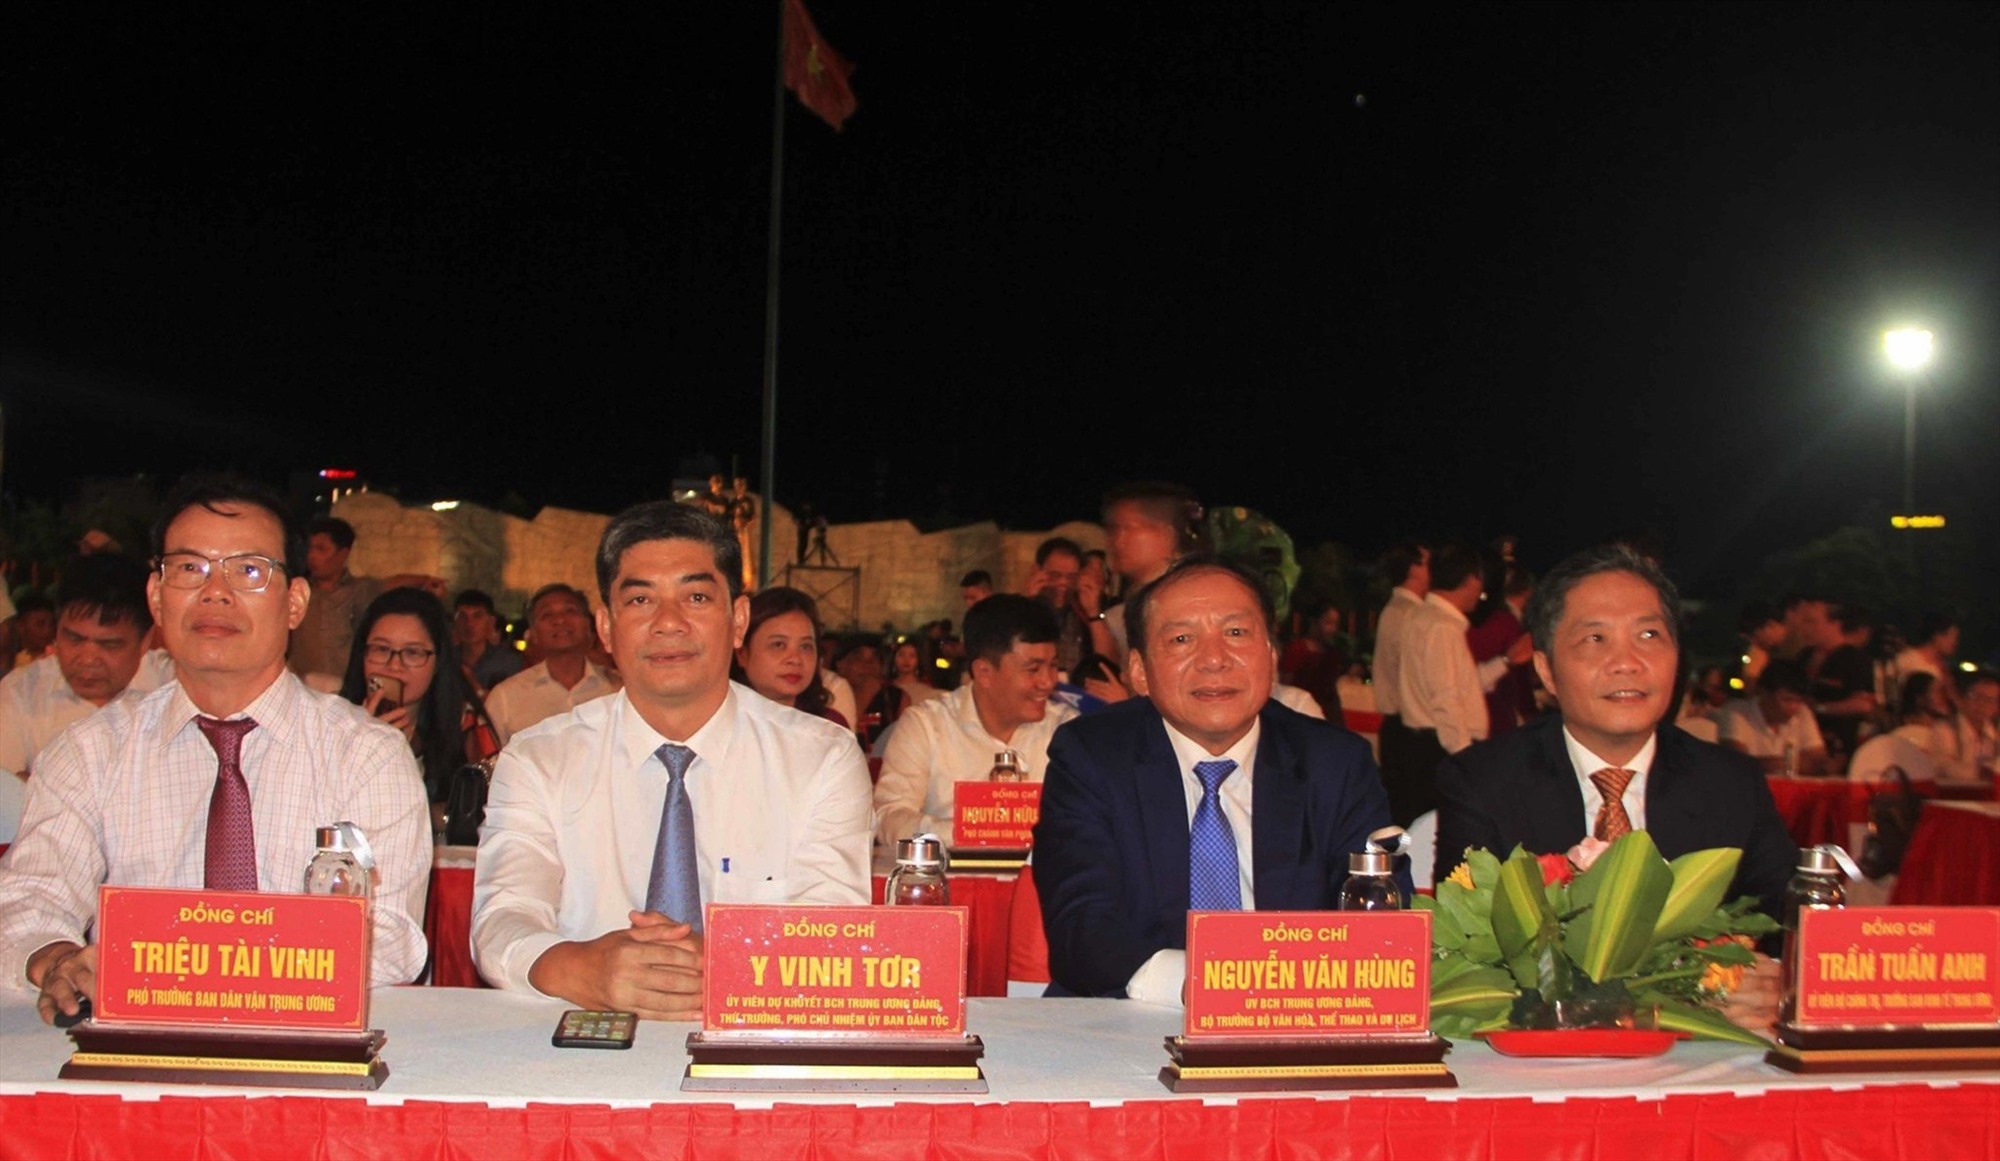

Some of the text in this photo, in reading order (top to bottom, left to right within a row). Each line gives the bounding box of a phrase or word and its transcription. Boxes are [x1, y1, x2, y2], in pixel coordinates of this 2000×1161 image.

[179, 901, 274, 925] ĐỒNG CHÍ
[783, 916, 875, 938] ĐỒNG CHÍ
[1262, 921, 1348, 942] ĐỒNG CHÍ
[1861, 916, 1936, 936] ĐỒNG CHÍ
[131, 936, 335, 981] TRIỆU TÀI VINH
[1204, 949, 1415, 989] NGUYỄN VĂN HÙNG
[1818, 943, 1876, 981] TRẦN
[1940, 953, 1987, 981] ANH
[750, 954, 921, 988] Y VINH TƠR
[127, 985, 335, 1012] PHÓ TRƯỞNG BAN DÂN VẬN TRUNG ƯƠNG
[742, 994, 765, 1008] VIÊN
[824, 997, 844, 1009] BCH
[848, 998, 880, 1009] TRUNG
[1260, 998, 1280, 1009] BCH
[1283, 997, 1314, 1009] TRUNG
[787, 1012, 807, 1024] PHÓ
[832, 1013, 865, 1027] NHIỆM
[883, 1015, 904, 1025] BAN
[907, 1014, 928, 1025] DÂN
[930, 1014, 949, 1028] TỘC
[1339, 1014, 1363, 1025] THAO
